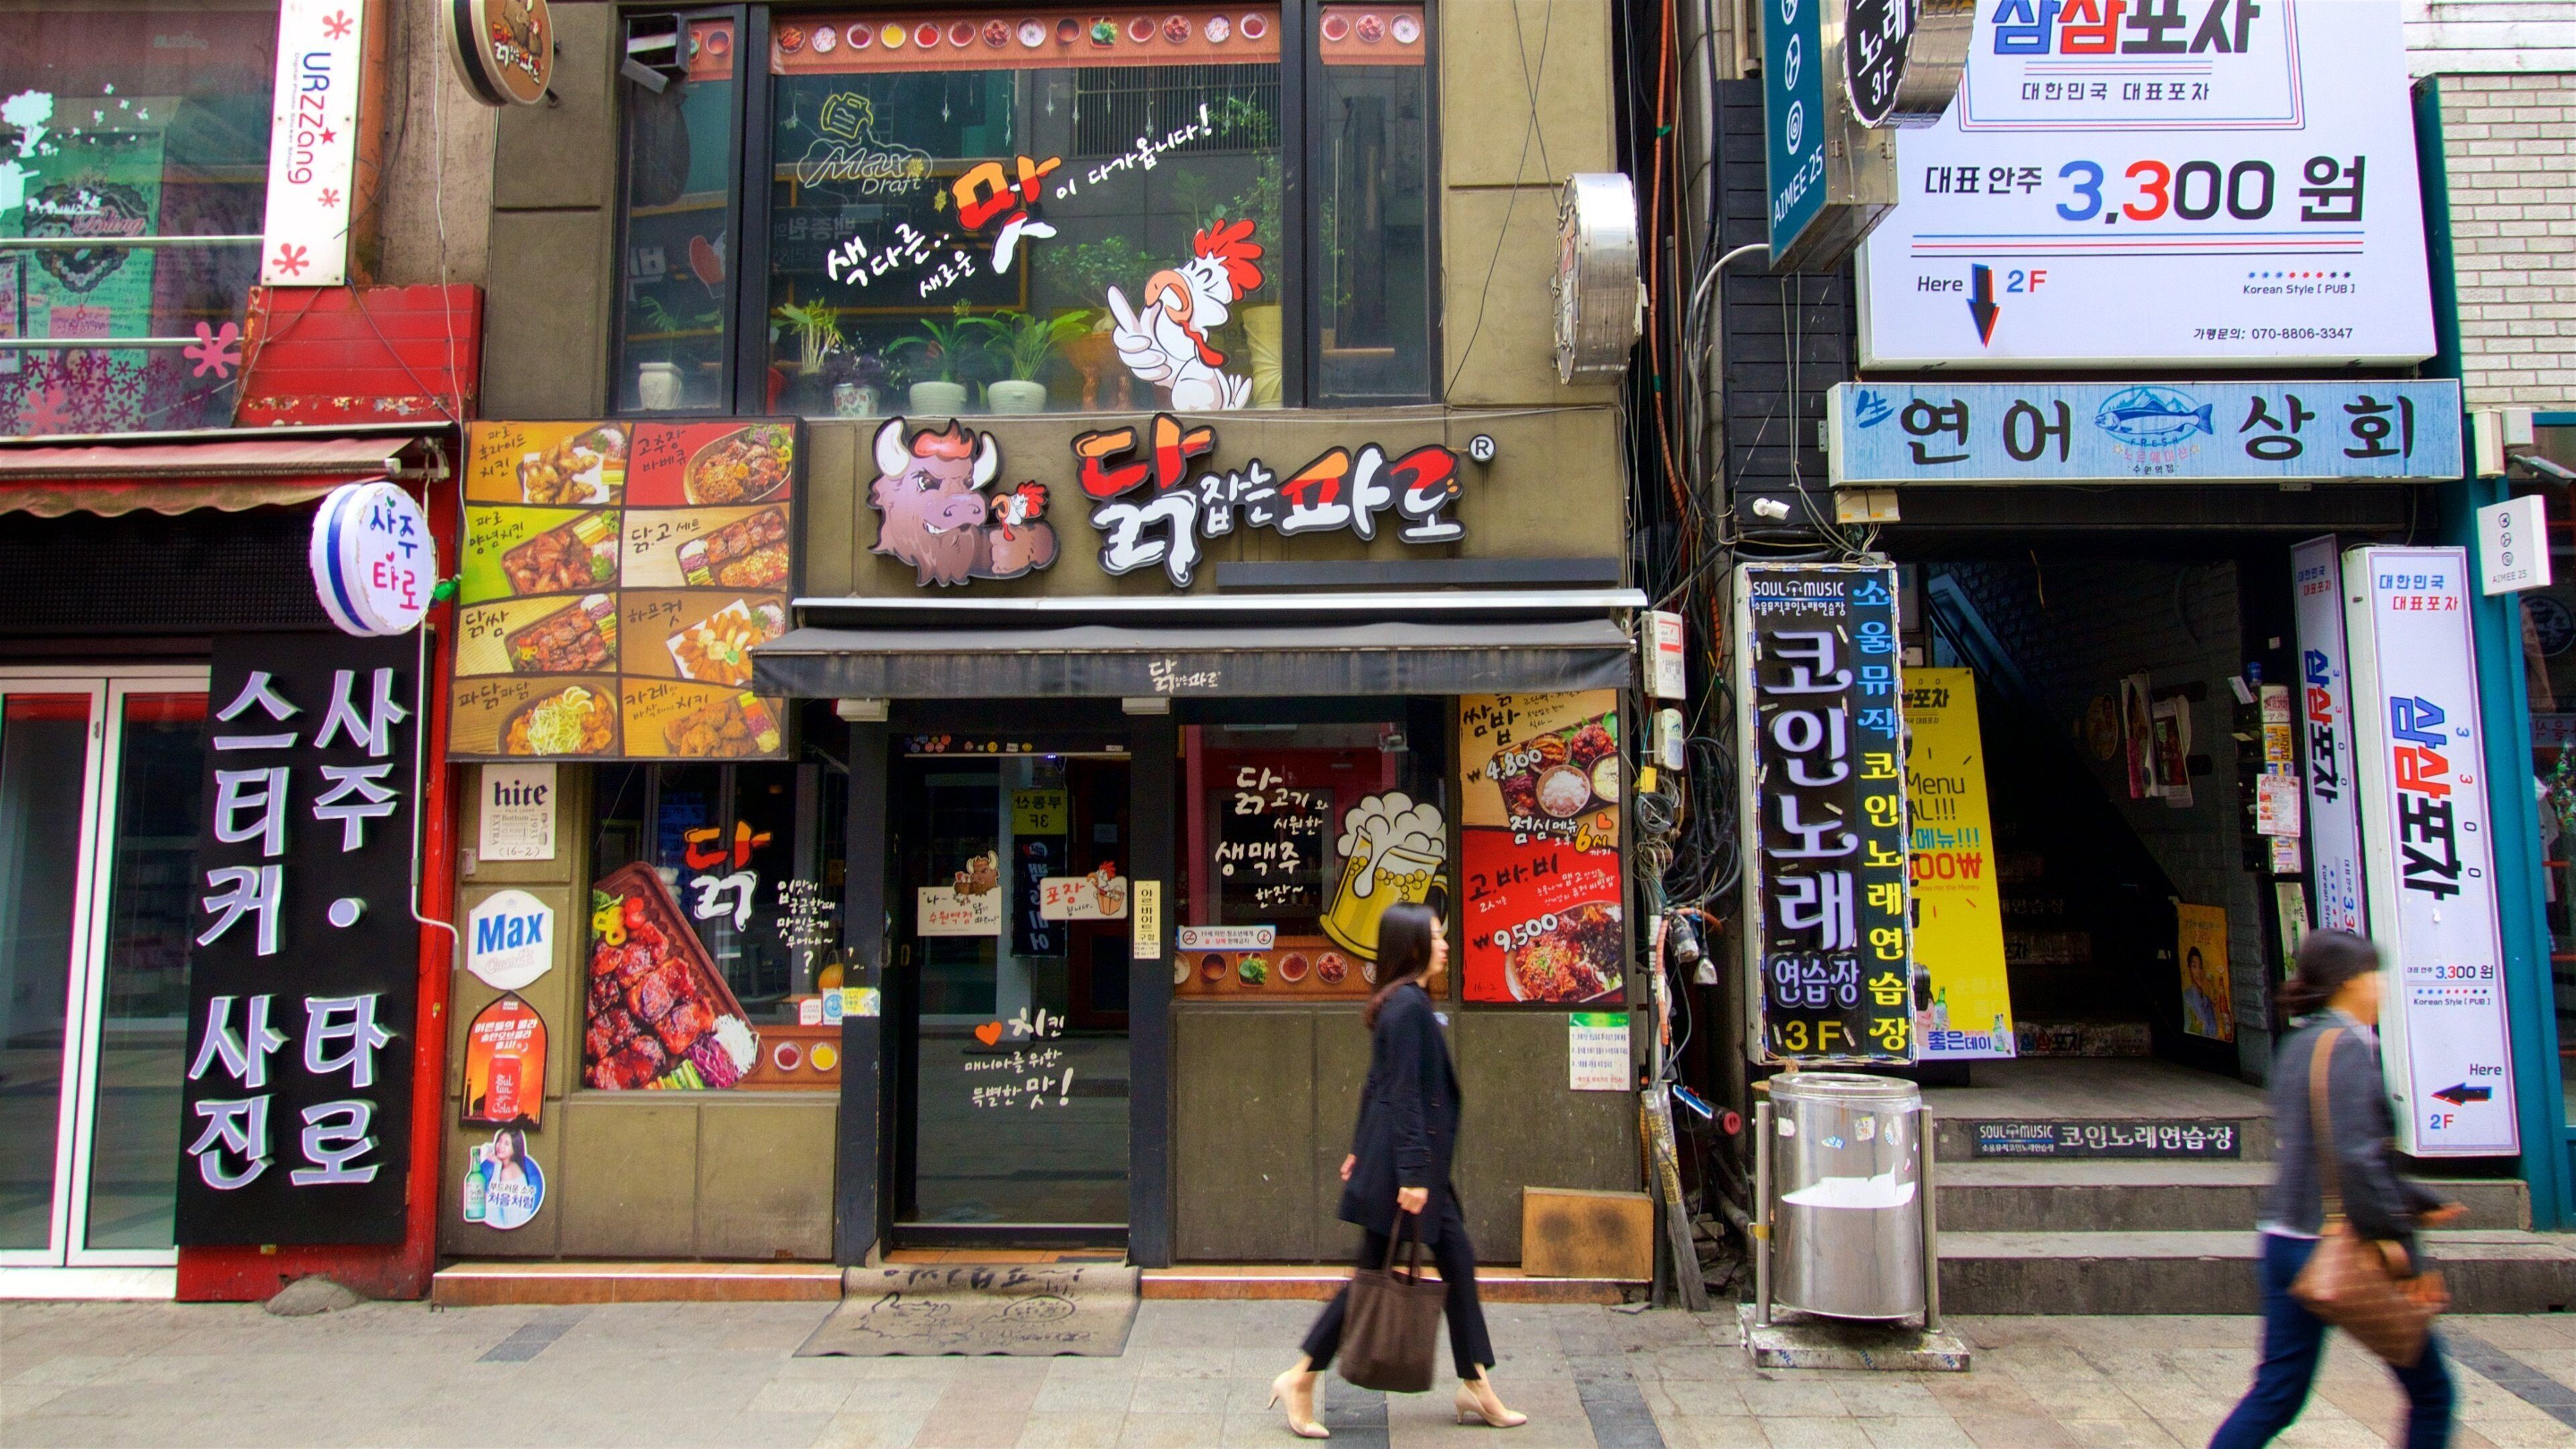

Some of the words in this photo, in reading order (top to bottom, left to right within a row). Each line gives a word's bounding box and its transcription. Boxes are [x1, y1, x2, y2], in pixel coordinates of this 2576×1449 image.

[1872, 57, 1893, 105] 3F
[2021, 83, 2108, 101] 대한민국
[2123, 83, 2210, 101] 대표포차
[1774, 165, 1807, 228] AIMEE
[1809, 144, 1824, 184] 25
[2298, 155, 2366, 222] 원
[1917, 275, 1964, 292] Here
[2006, 270, 2047, 293] 2F
[2243, 284, 2283, 294] Korean
[2286, 284, 2315, 296] Style
[2251, 327, 2353, 340] 070-8806-3347
[638, 429, 686, 456] 고추장
[2131, 437, 2179, 447] FRESH
[370, 505, 418, 559] 사주
[373, 562, 419, 610] 타로
[1753, 581, 1786, 597] SOUL
[1804, 581, 1845, 597] MUSIC
[2379, 574, 2445, 590] 대한민국
[2393, 596, 2458, 610] 대표포차
[494, 780, 548, 806] hite
[2390, 696, 2462, 901] 삼삼포차
[197, 670, 298, 956] 스티커
[1215, 841, 1301, 877] 생맥주
[684, 819, 773, 932] 닭
[1046, 882, 1085, 905] 포장
[477, 912, 544, 955] Max
[1776, 958, 1860, 1004] 연습장
[2445, 998, 2462, 1006] Style
[1008, 1007, 1065, 1037] 치킨
[1785, 1020, 1842, 1051] 3F
[2469, 1064, 2502, 1076] Here
[187, 994, 284, 1191] 사진
[1980, 1125, 2006, 1139] SOUL
[2020, 1125, 2053, 1139] MUSIC
[2430, 1114, 2454, 1130] 2F
[2059, 1126, 2233, 1150] 코인노래연습장
